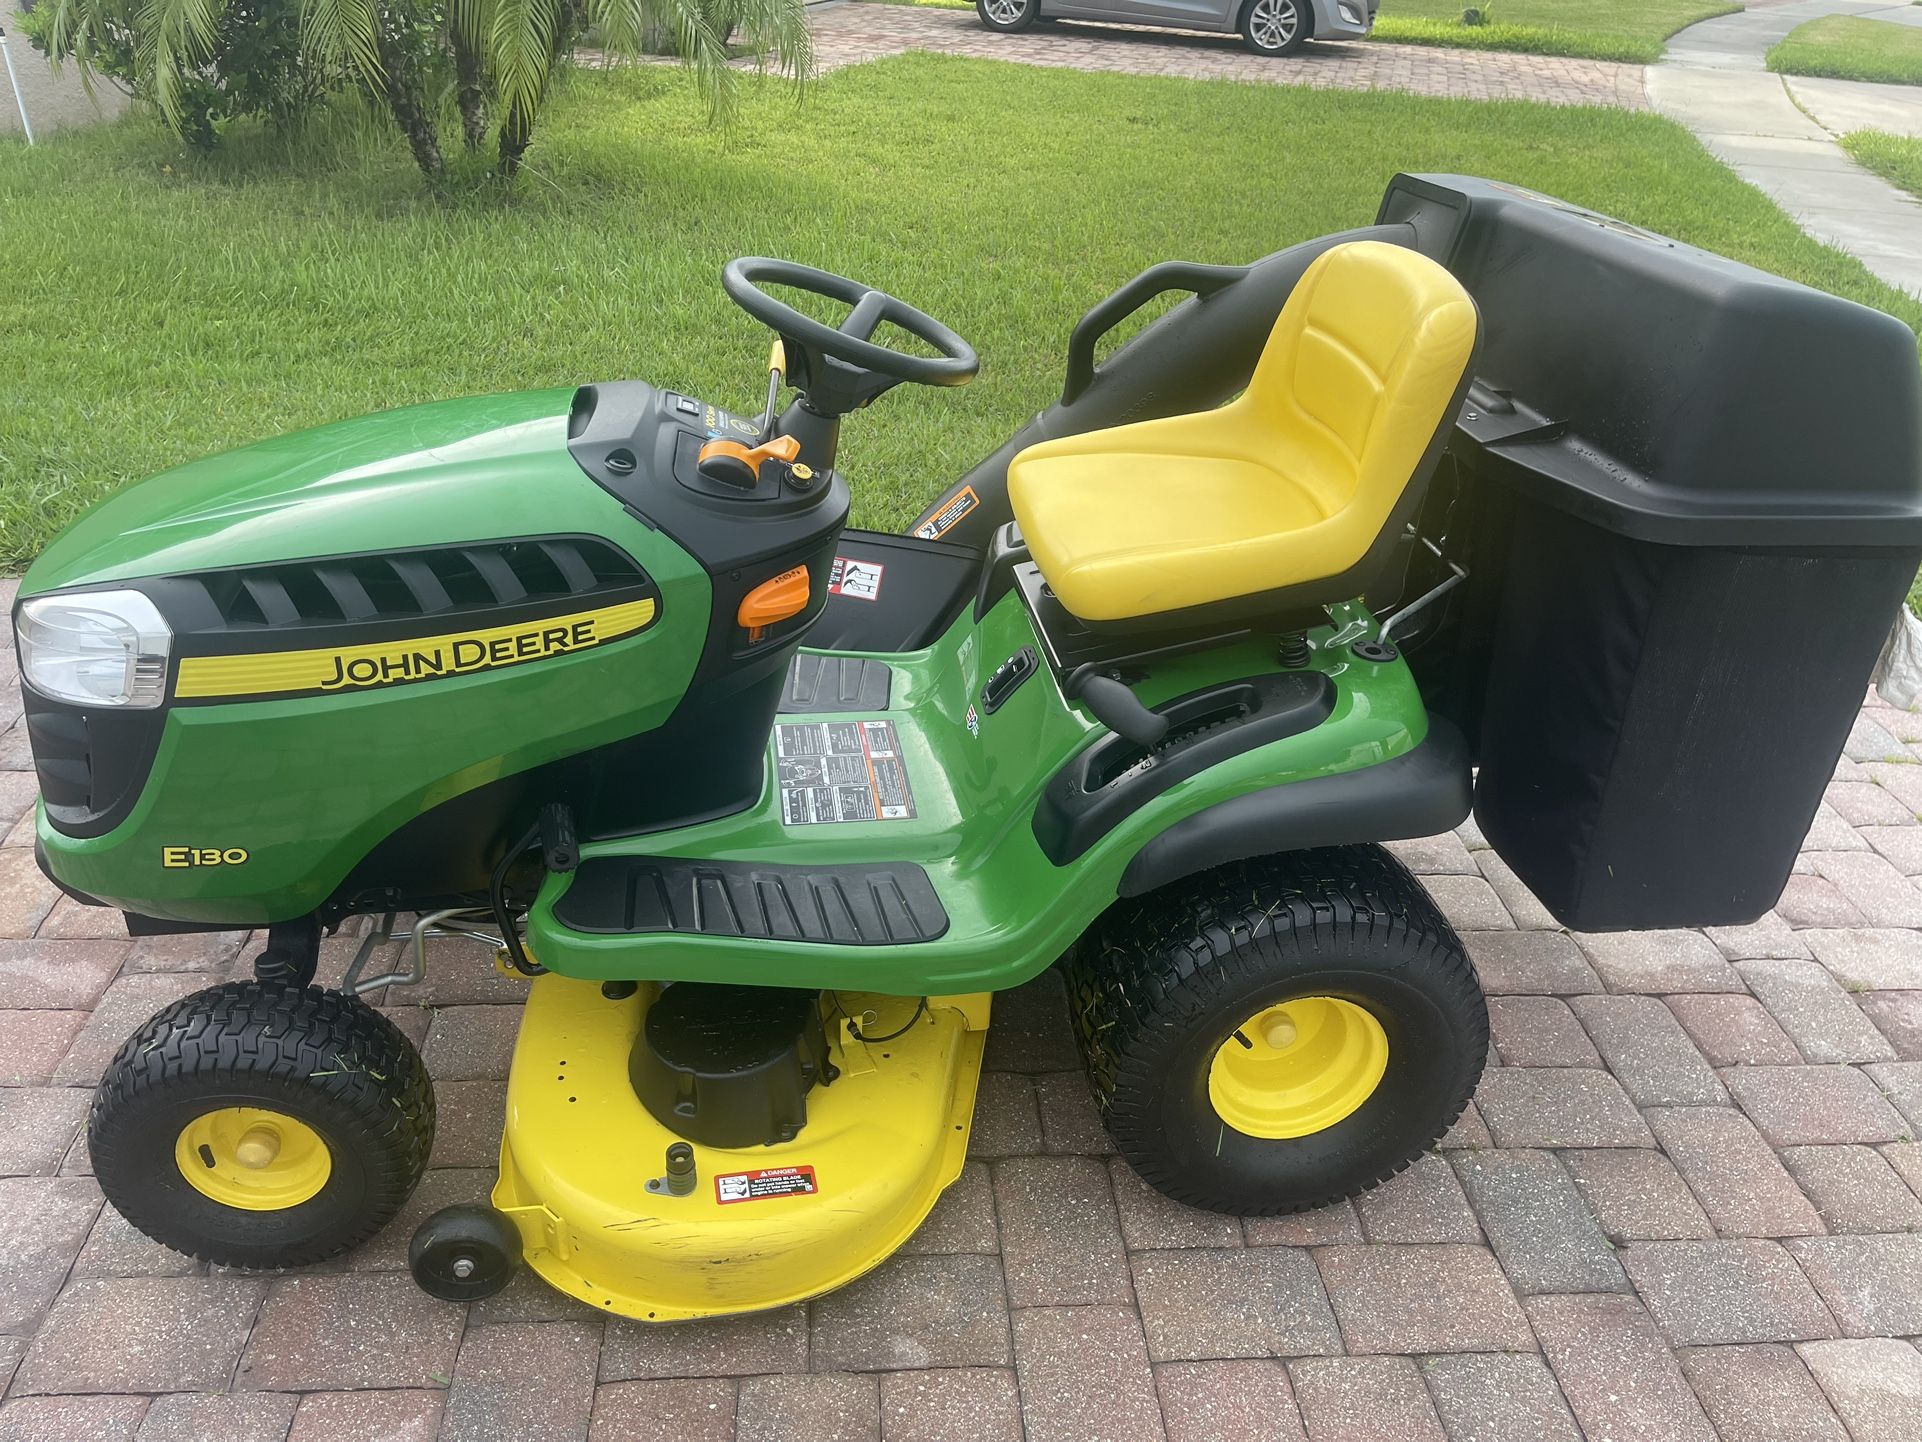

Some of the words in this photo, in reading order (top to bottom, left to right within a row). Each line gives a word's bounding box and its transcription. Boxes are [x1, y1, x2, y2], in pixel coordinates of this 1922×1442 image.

[321, 649, 444, 687] JOHN
[452, 620, 596, 669] DEERE
[163, 846, 248, 867] E130
[767, 1168, 797, 1176] DANGER
